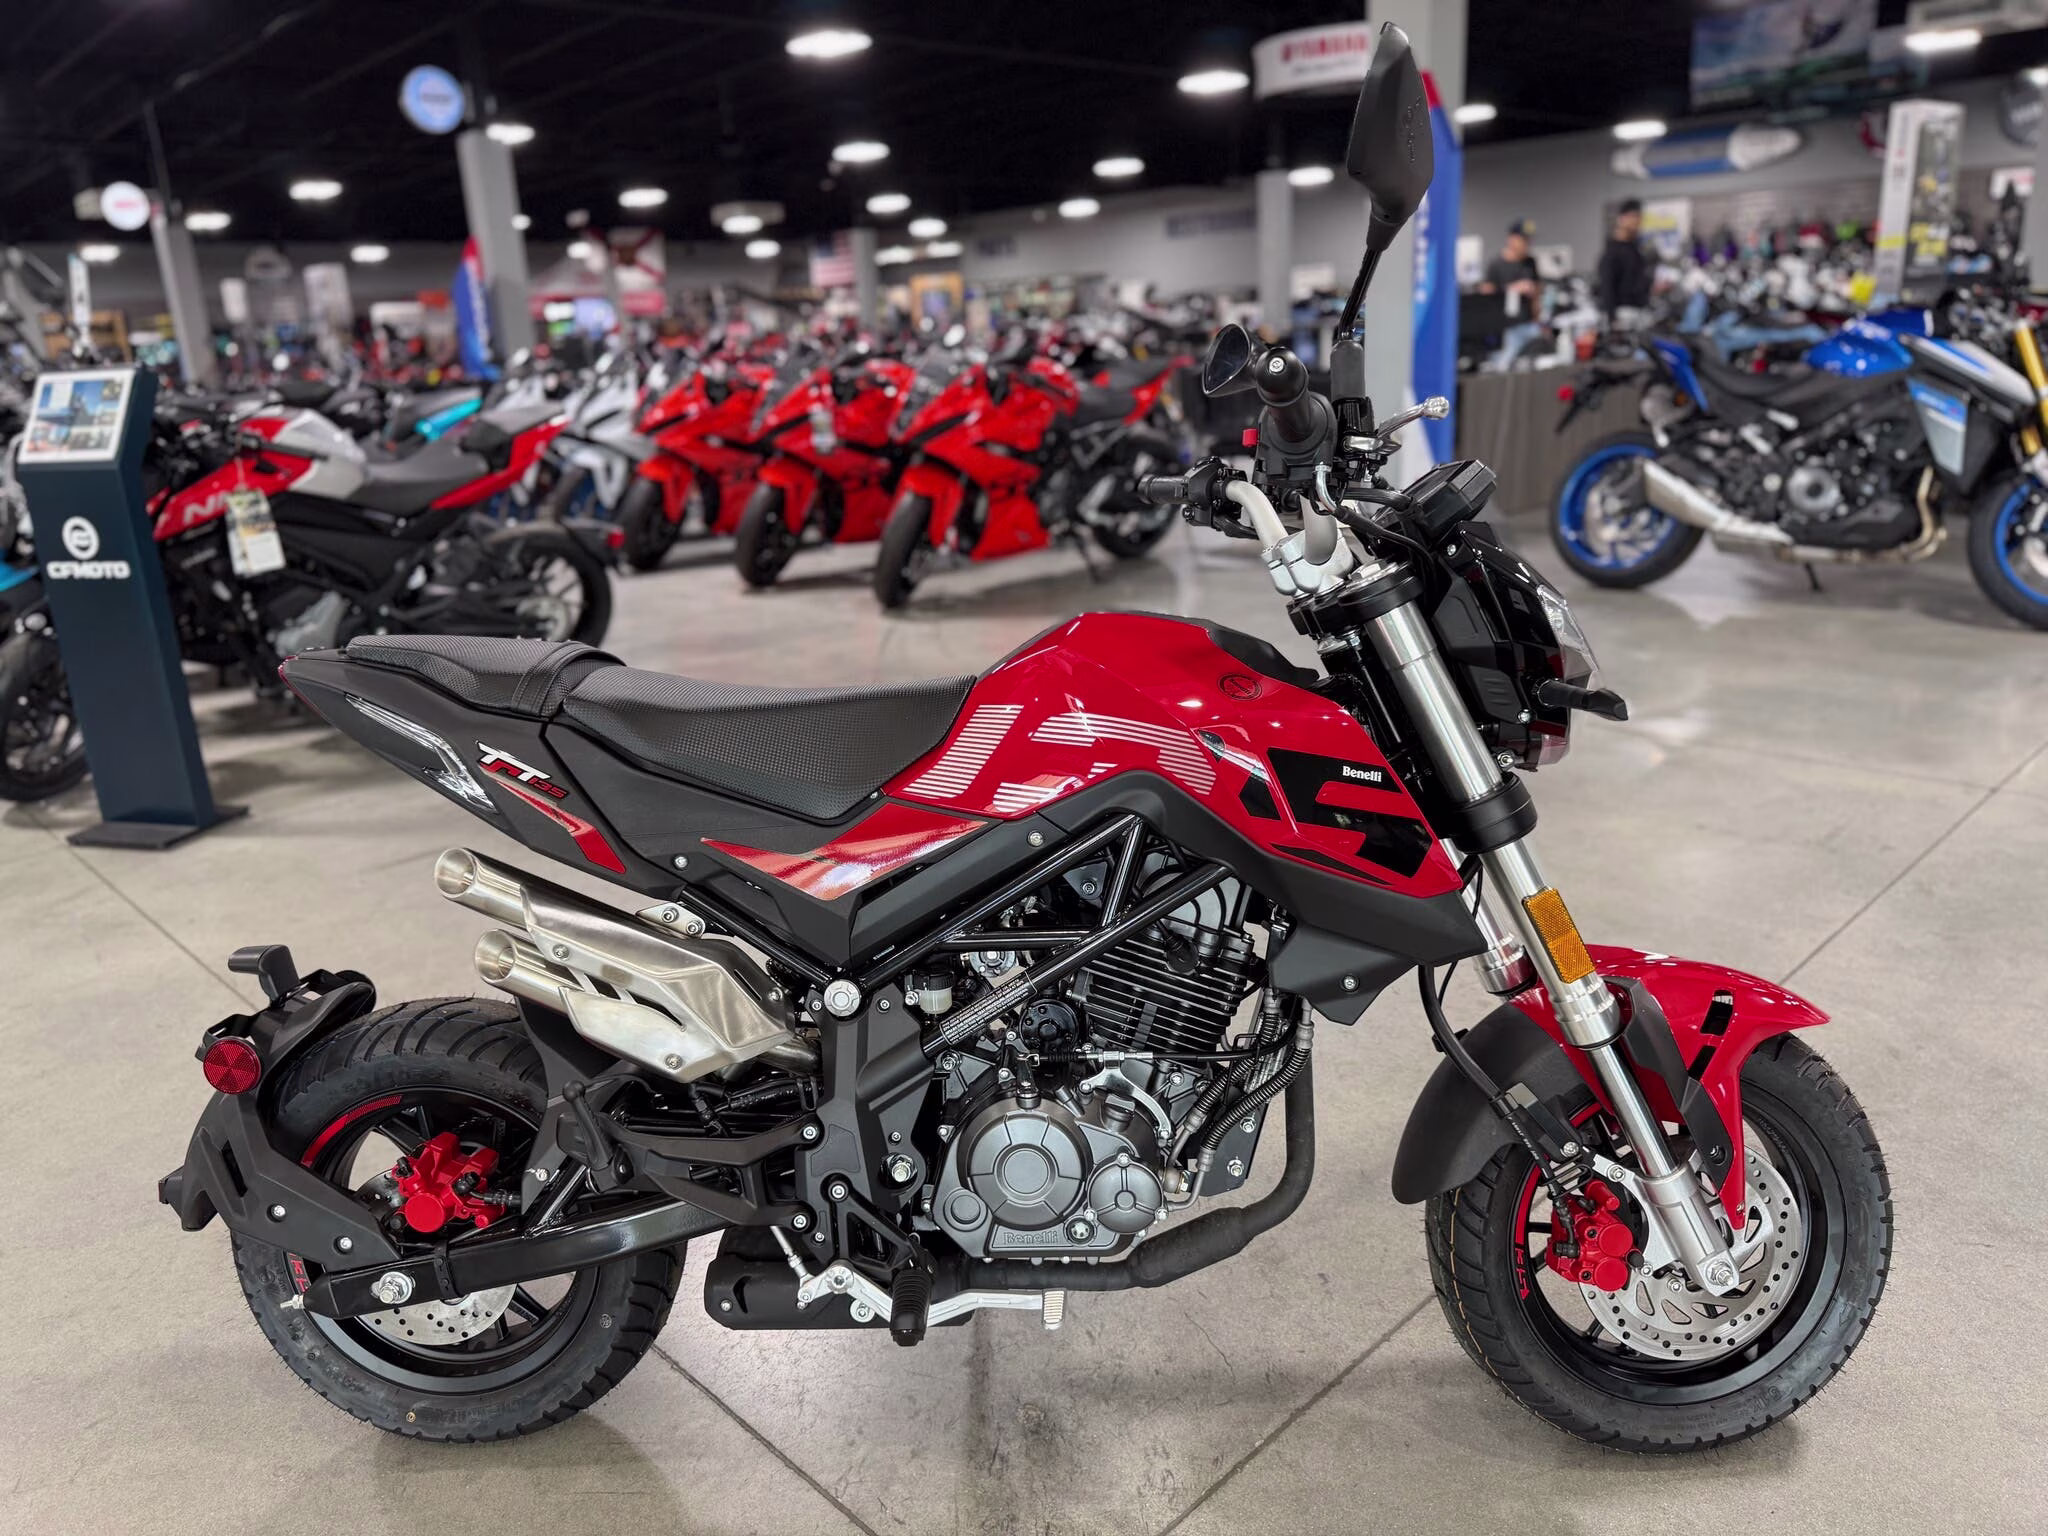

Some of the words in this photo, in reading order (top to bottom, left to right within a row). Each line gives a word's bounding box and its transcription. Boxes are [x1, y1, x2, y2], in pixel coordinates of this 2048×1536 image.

[46, 560, 131, 580] CFMOTO
[1342, 765, 1382, 783] Benelli
[1003, 1230, 1059, 1245] Benelli
